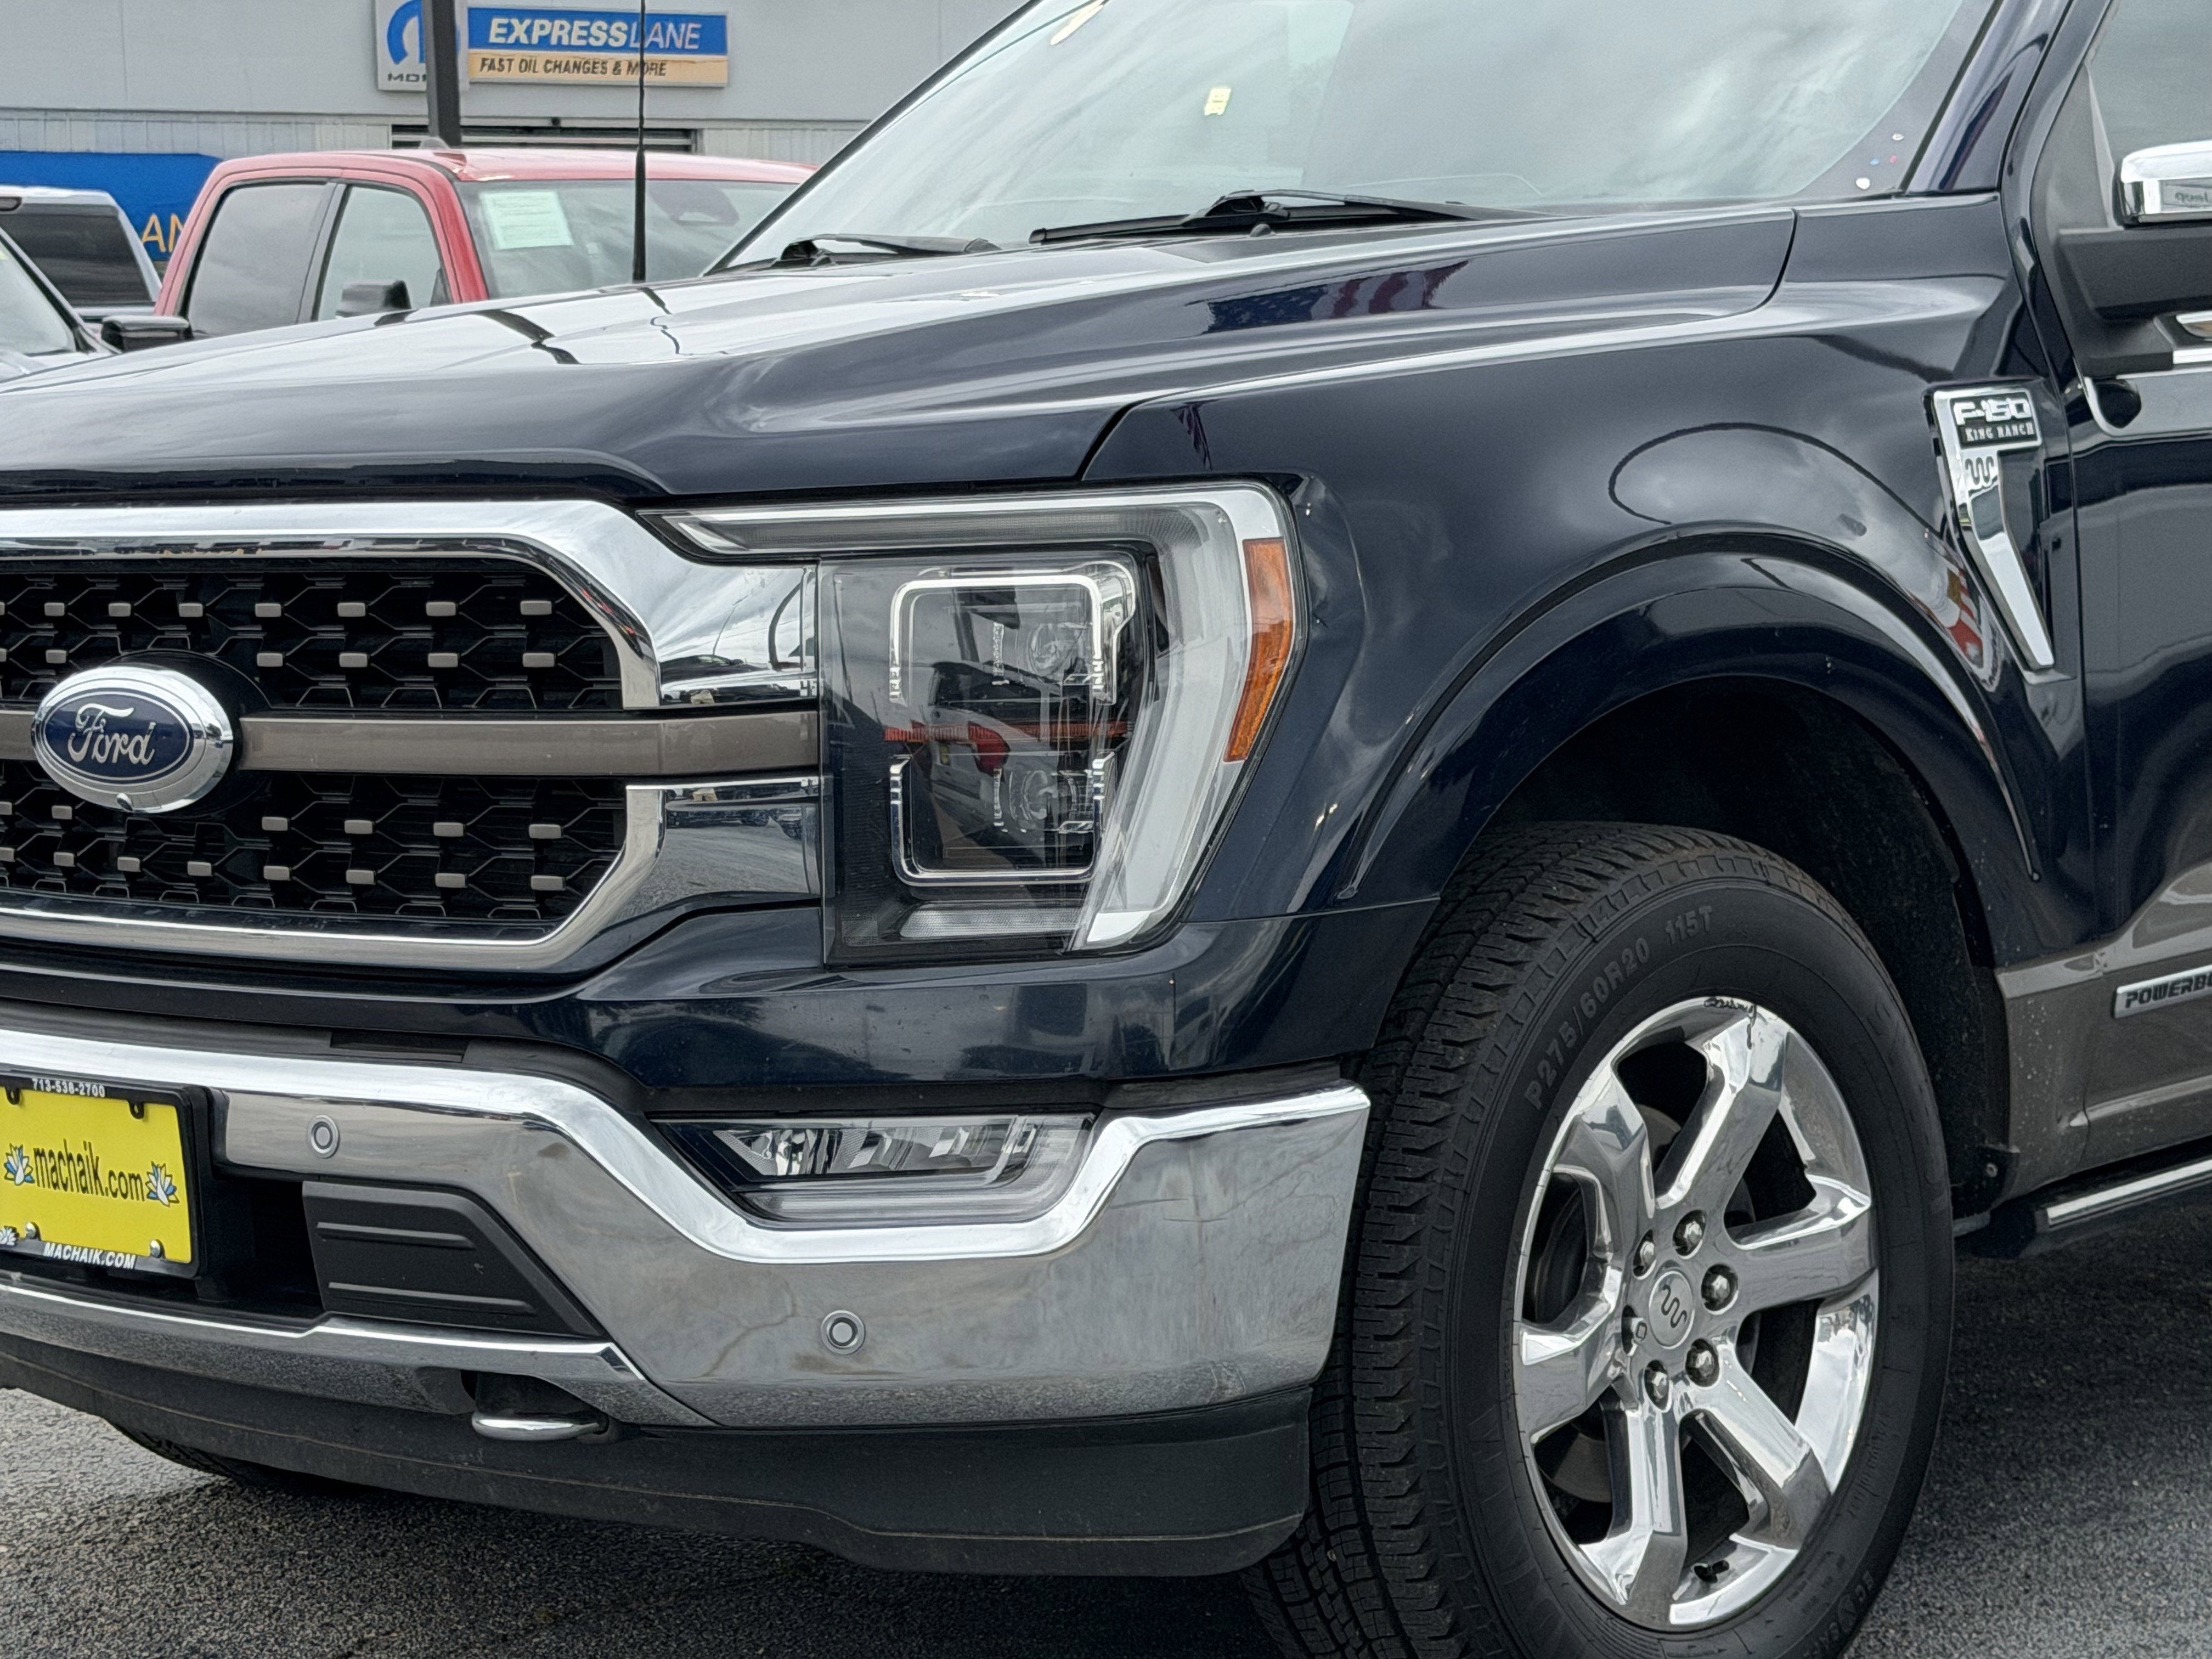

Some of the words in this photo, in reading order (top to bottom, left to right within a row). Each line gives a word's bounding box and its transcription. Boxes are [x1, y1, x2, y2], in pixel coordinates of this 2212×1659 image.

[479, 57, 514, 72] FAST
[518, 58, 539, 74] OIL
[543, 59, 608, 75] CHANGES
[612, 60, 622, 75] &
[1953, 398, 2032, 425] F-150
[1965, 426, 1994, 442] KING
[1996, 421, 2035, 438] RANCH
[68, 703, 156, 765] Ford
[1525, 937, 1650, 1110] P275/60R20
[1664, 905, 1713, 945] 115T
[32, 1077, 105, 1098] 713-538-2700
[33, 1138, 145, 1203] machaik.com
[43, 1242, 137, 1270] MACHAIK.COM
